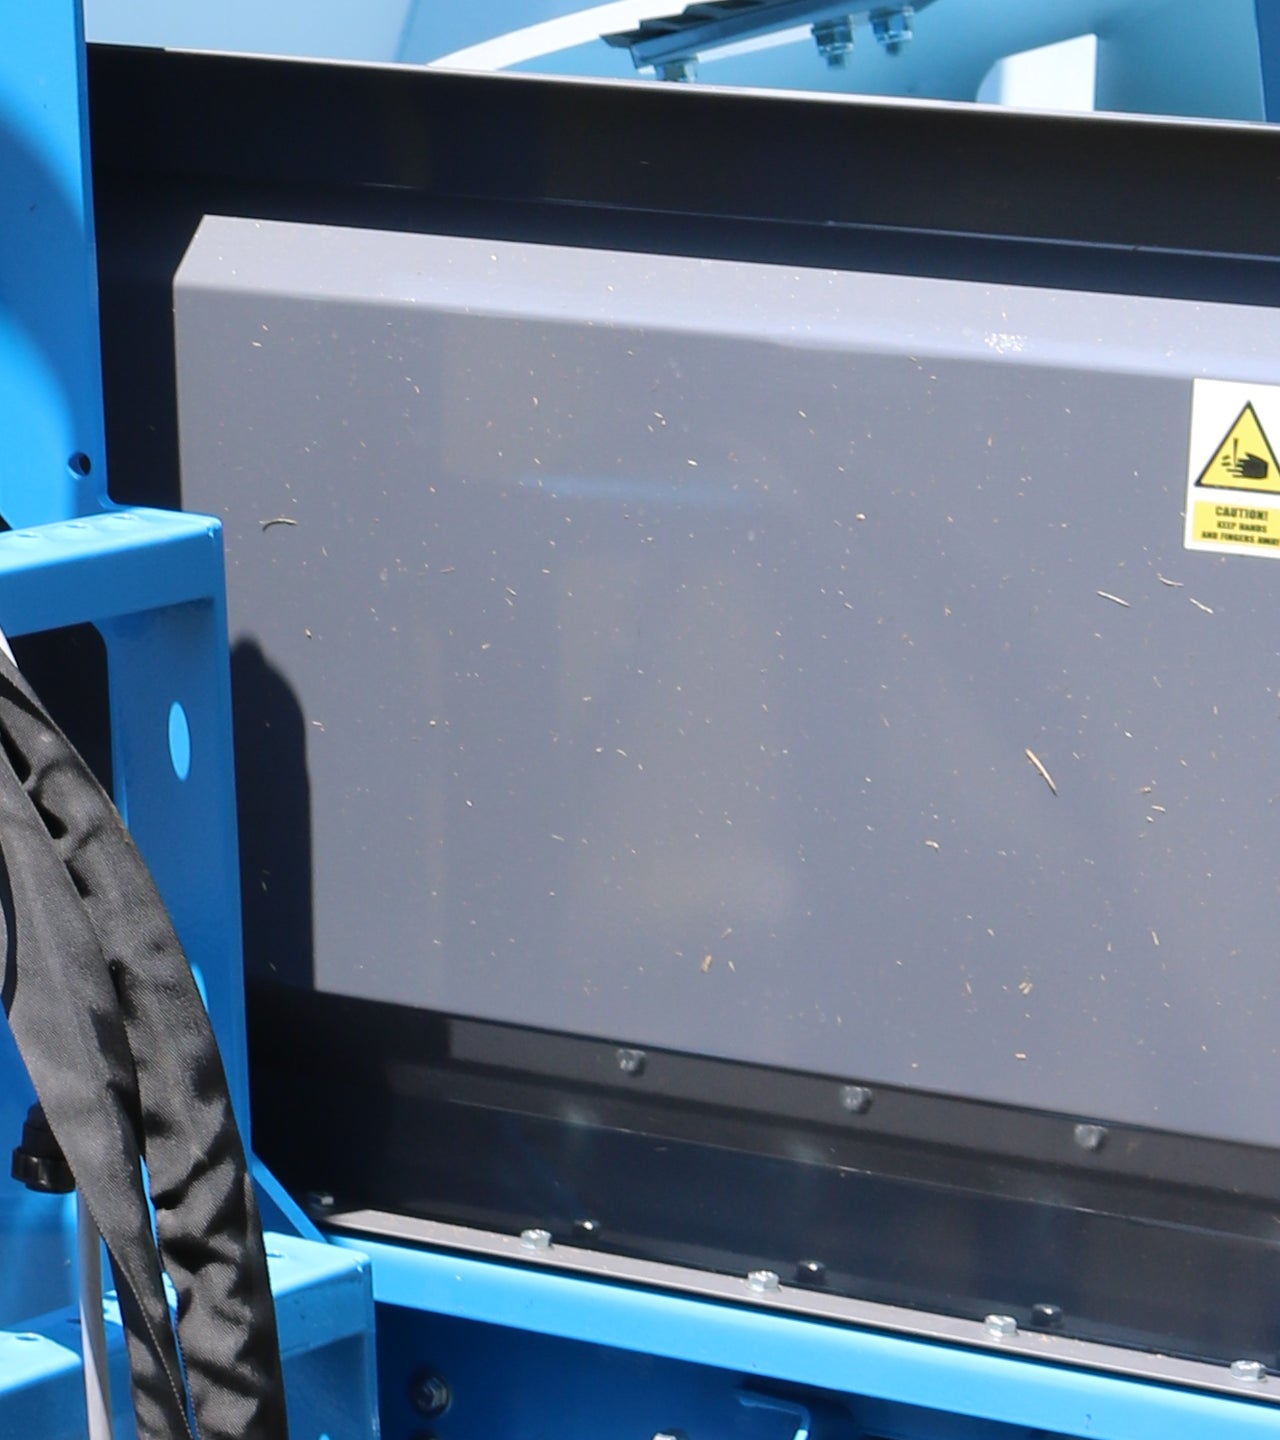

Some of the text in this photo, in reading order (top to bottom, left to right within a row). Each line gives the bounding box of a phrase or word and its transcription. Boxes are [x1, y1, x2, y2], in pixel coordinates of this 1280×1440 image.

[1215, 506, 1268, 521] CAUTION!
[1217, 521, 1267, 533] KEEP HANDS
[1201, 531, 1218, 539] AND
[1220, 532, 1255, 543] FINGERS
